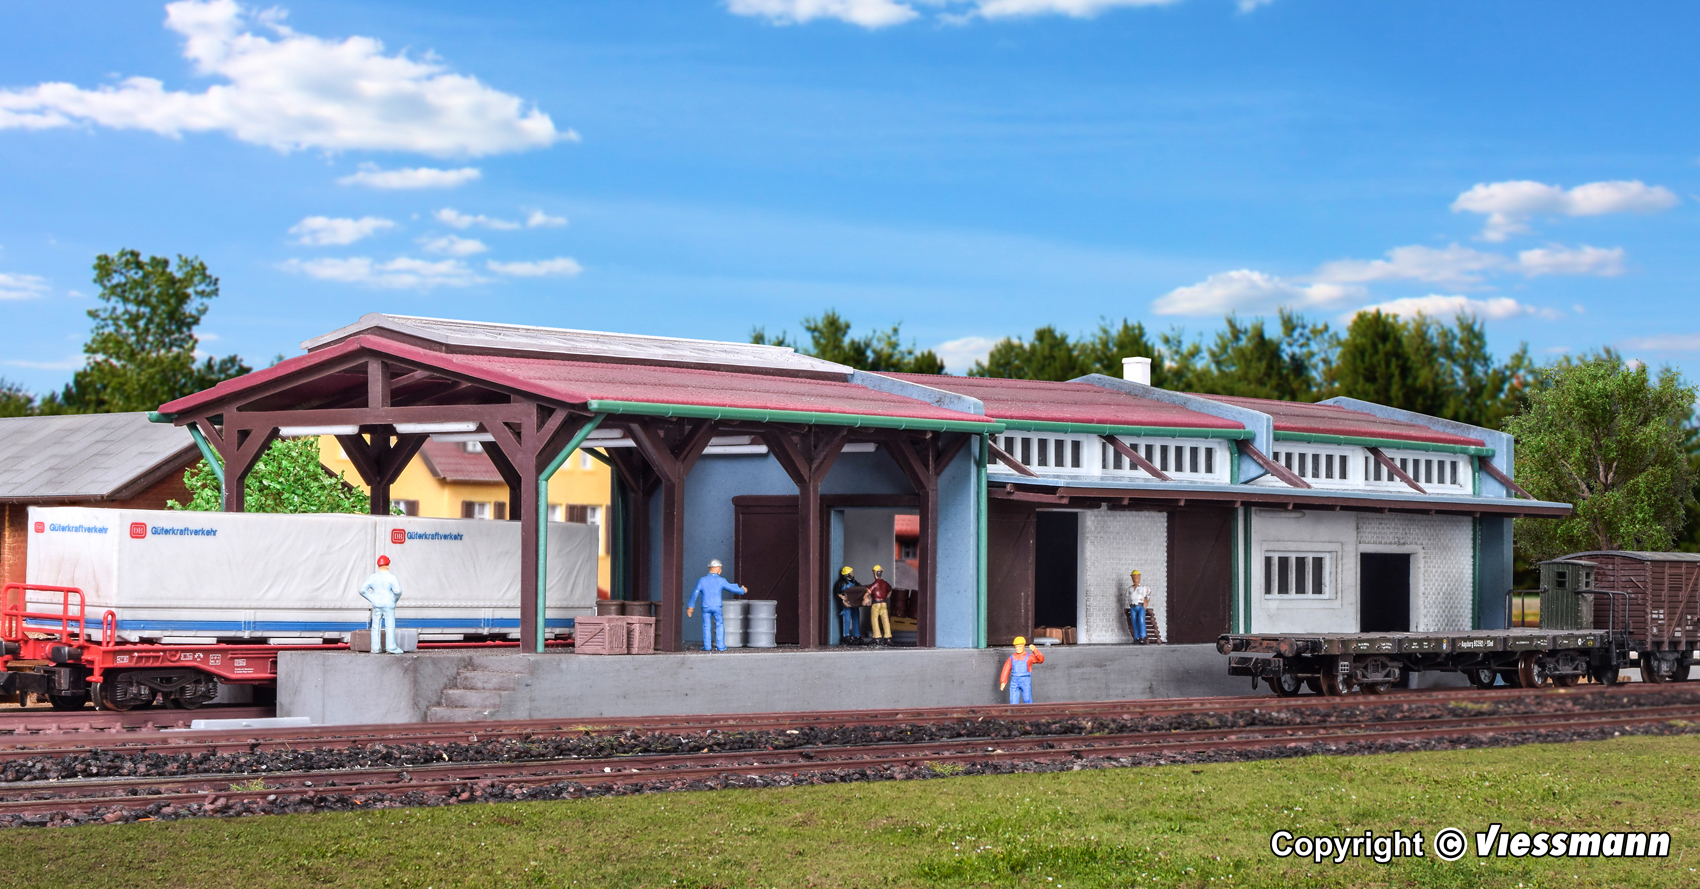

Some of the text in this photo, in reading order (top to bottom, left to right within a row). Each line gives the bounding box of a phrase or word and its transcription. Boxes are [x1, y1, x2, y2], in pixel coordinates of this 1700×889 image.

[49, 523, 108, 534] Güterkraftverkehr
[151, 526, 217, 536] Güterkraftverkehr
[406, 531, 464, 541] Güterkraftverkehr
